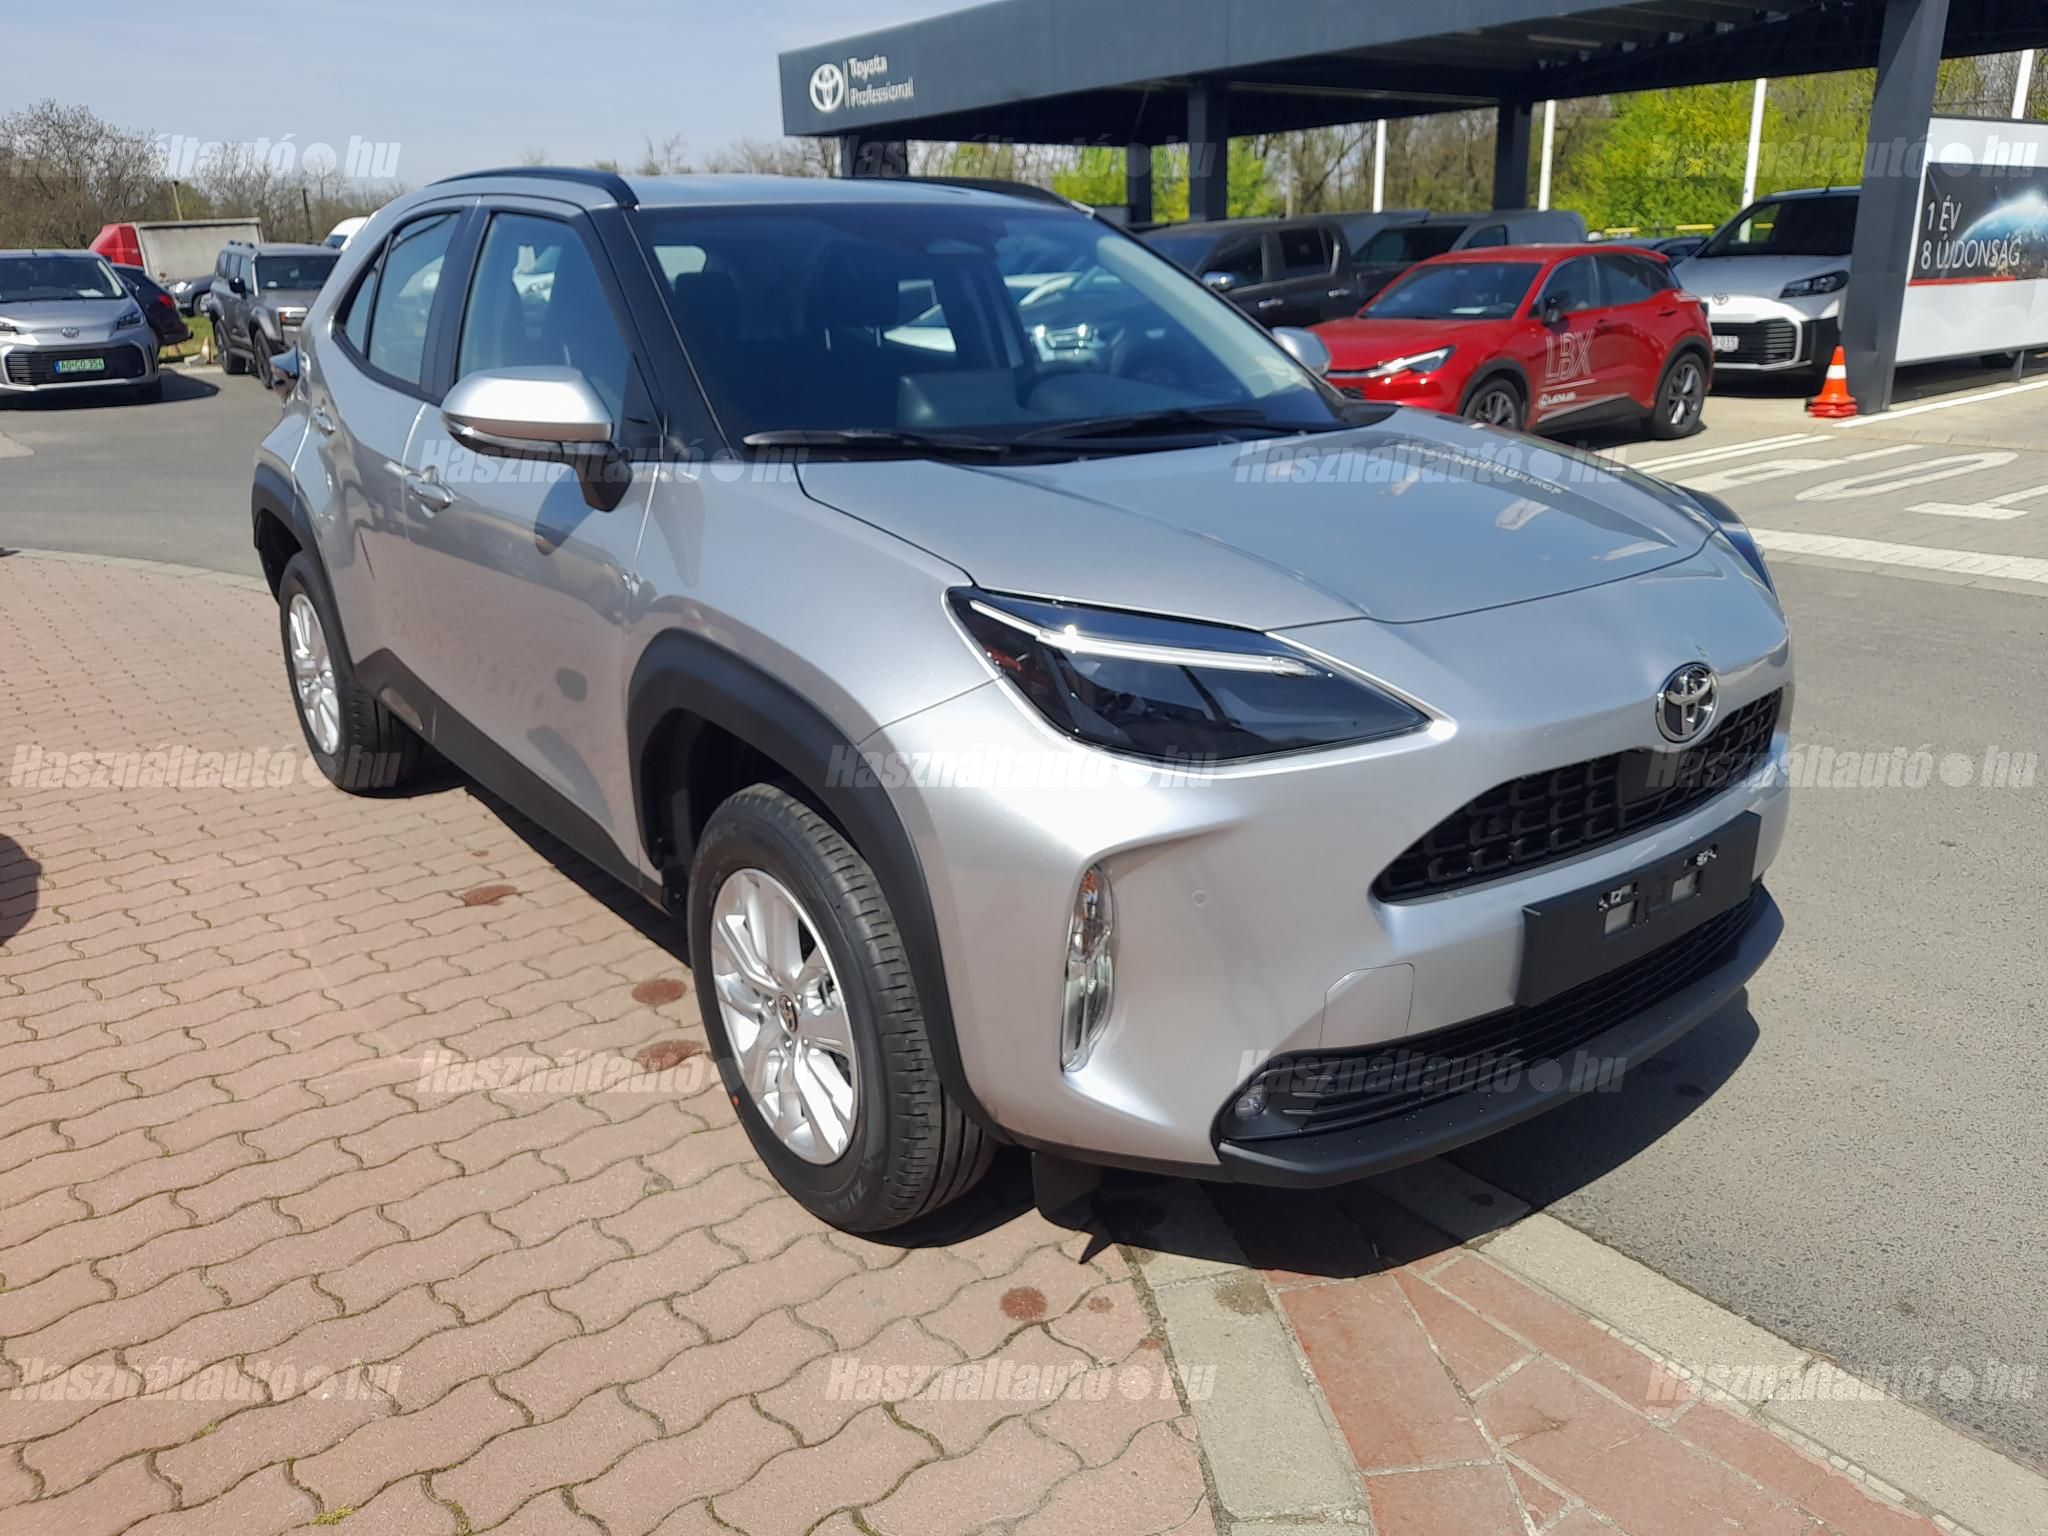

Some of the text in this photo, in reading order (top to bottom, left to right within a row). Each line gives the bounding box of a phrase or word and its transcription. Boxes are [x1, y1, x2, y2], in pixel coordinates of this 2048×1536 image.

[848, 54, 888, 81] Toyota
[849, 76, 914, 107] Professional
[1927, 194, 1962, 232] 1 ÉV
[1921, 232, 2022, 270] 8 ÚJDONSÁG
[1544, 328, 1595, 381] LBX
